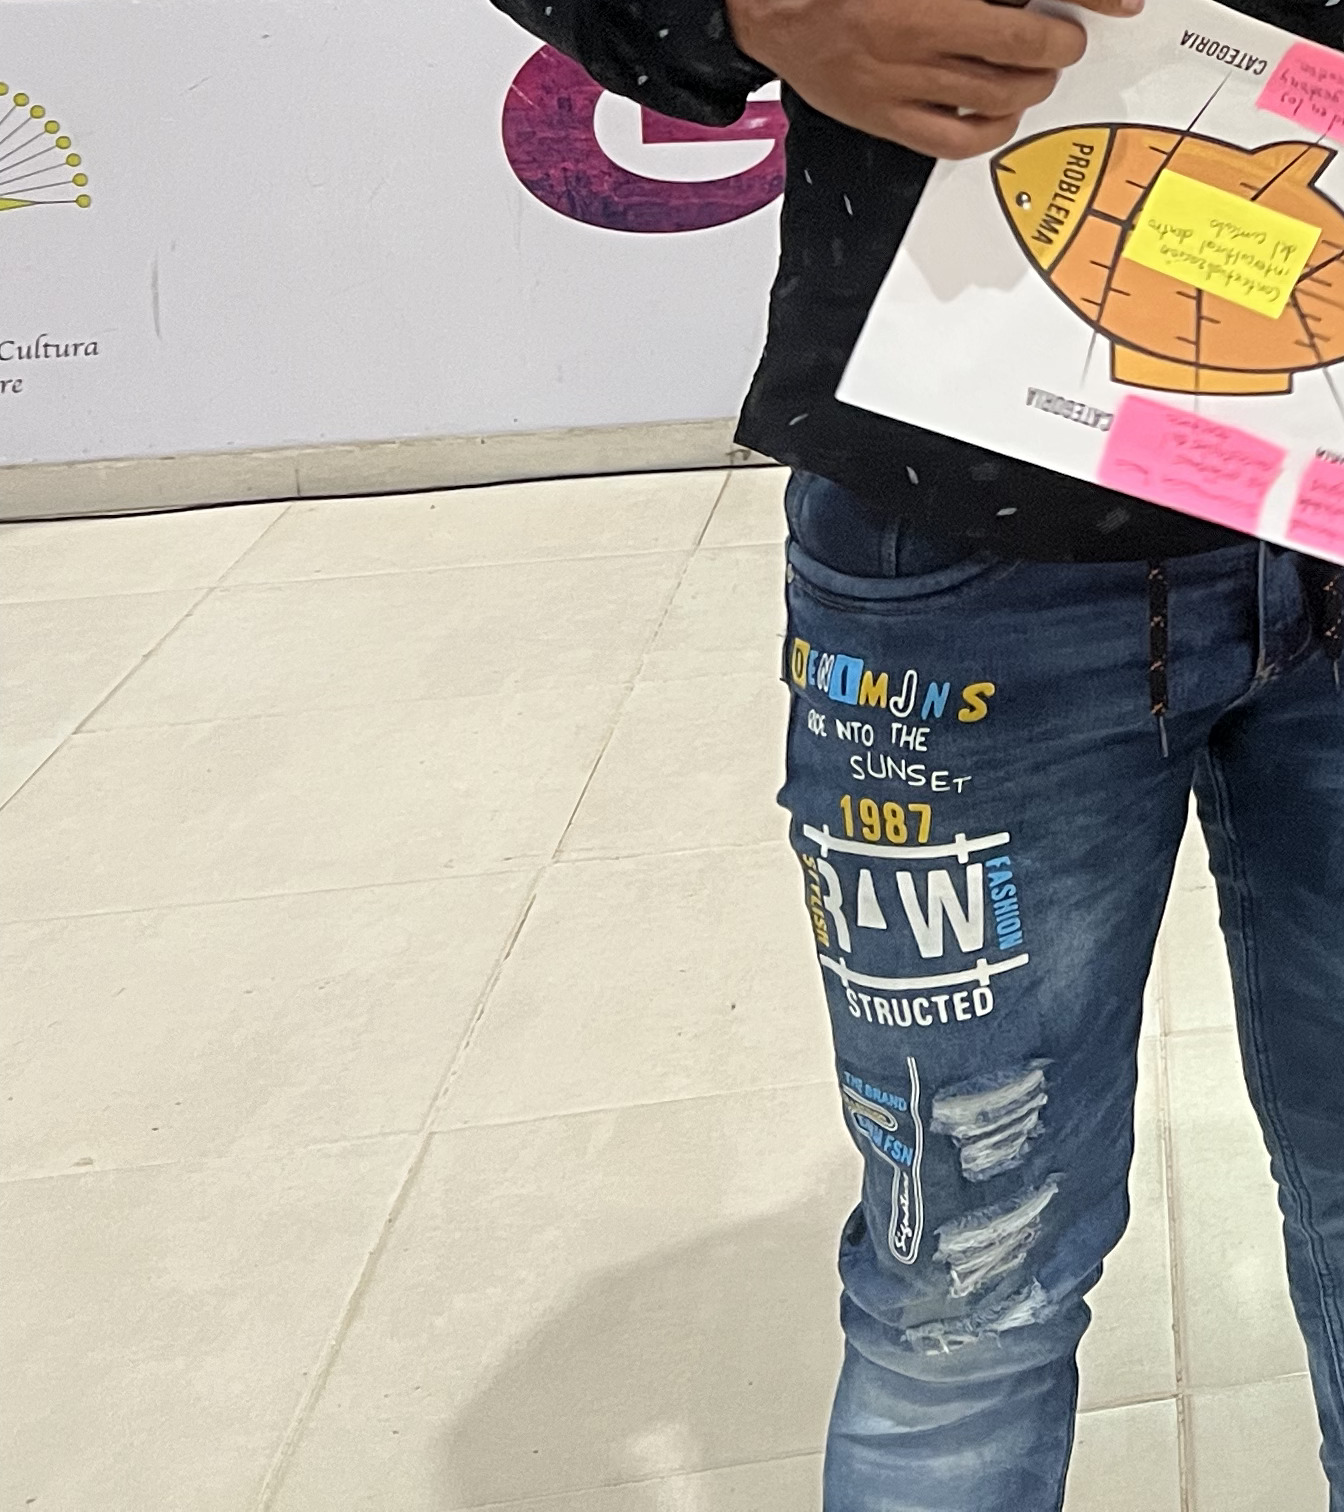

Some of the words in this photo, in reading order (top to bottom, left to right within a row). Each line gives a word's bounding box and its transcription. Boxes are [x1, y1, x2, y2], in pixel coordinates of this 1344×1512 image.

[1179, 29, 1269, 76] CATEGORIA
[1031, 141, 1095, 245] PROBLEMA
[0, 332, 99, 361] Cultura
[891, 721, 931, 752] THE
[850, 751, 973, 794] SUNSET
[839, 794, 932, 845] 1987
[985, 855, 1024, 951] FASHION
[845, 986, 994, 1028] STRUCTED
